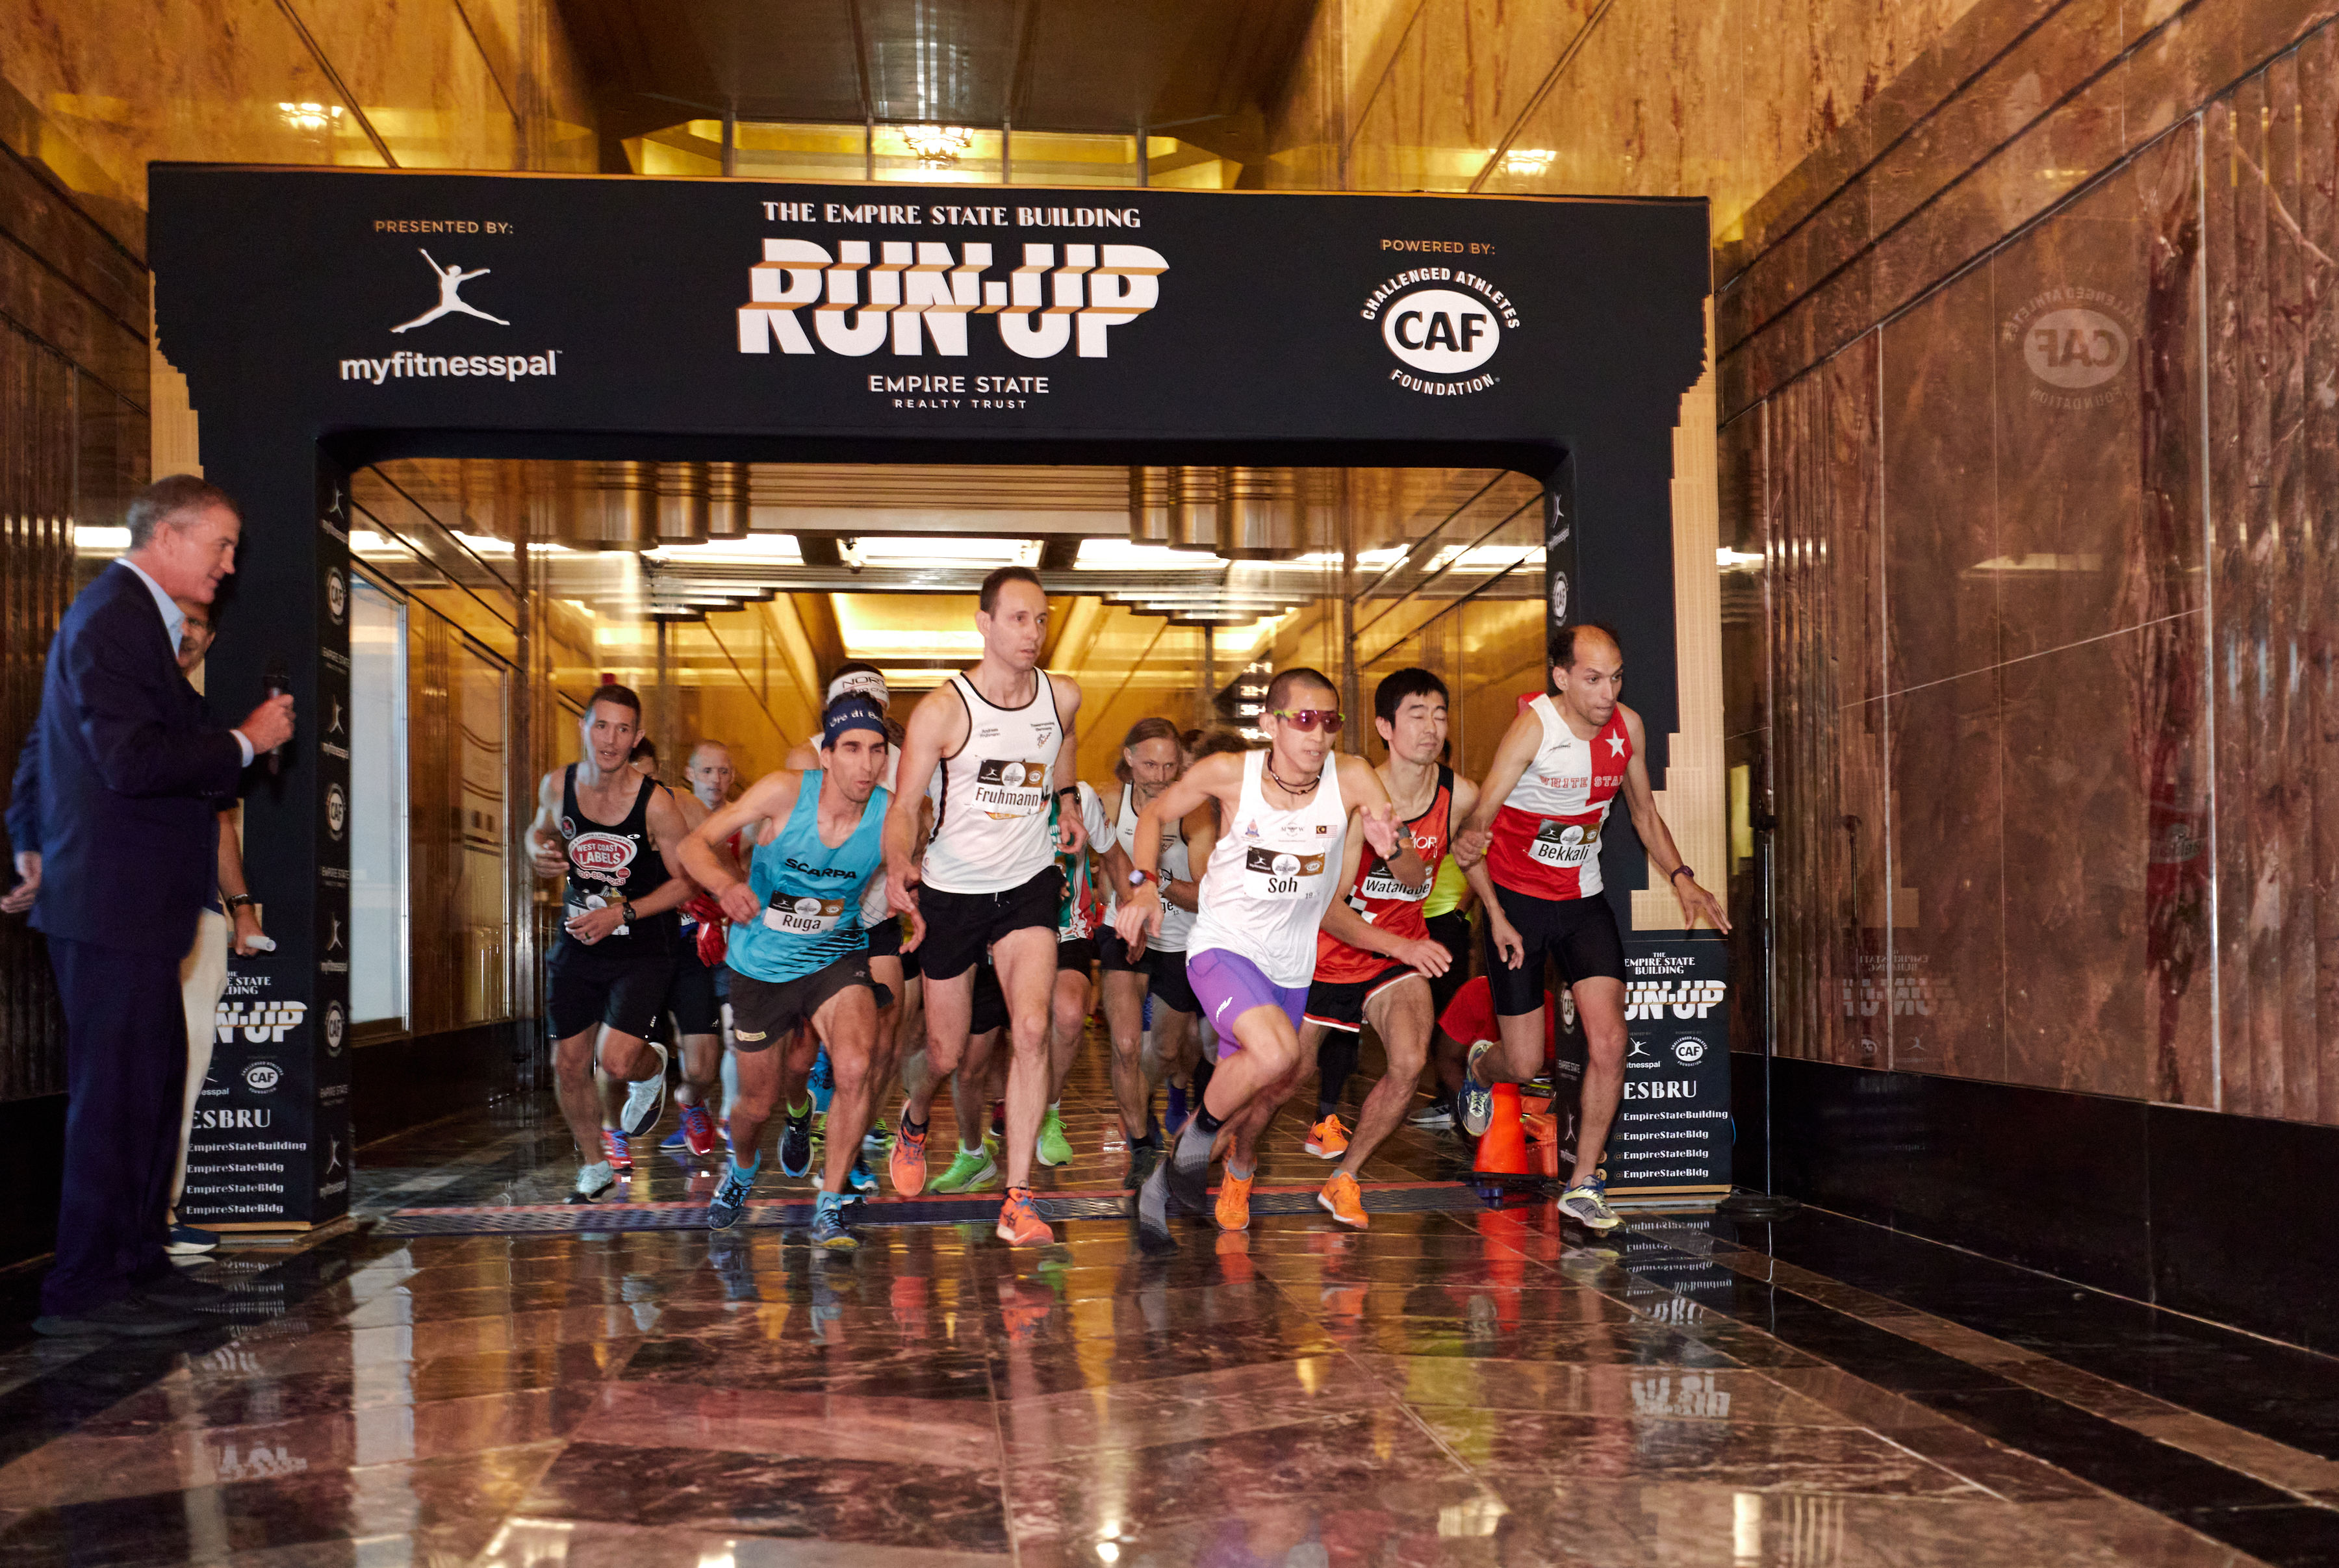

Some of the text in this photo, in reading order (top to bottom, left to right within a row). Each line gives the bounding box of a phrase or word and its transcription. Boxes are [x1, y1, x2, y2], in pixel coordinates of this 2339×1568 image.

[763, 201, 1141, 228] THE EMPIRE STATE BUILDING
[374, 220, 514, 234] PRESENTED BY:
[1381, 239, 1496, 255] POWERED BY:
[737, 238, 1170, 359] RUN-UP
[1361, 267, 1520, 329] CHALLENGED ATHLETES
[1395, 310, 1487, 353] CAF
[869, 374, 1049, 394] EMPIRE STATE
[1389, 369, 1495, 396] FOUNDATION
[894, 398, 1027, 409] REALTY TRUST
[1539, 775, 1589, 789] WHITE
[975, 787, 1039, 807] Fruhmann
[577, 844, 619, 852] WEST COAST
[1538, 844, 1591, 861] Bekkali
[580, 852, 620, 865] LABELS
[785, 858, 857, 879] SCARPA
[1268, 877, 1297, 893] Soh
[782, 915, 821, 932] Ruga
[1624, 957, 1695, 967] EMPIRE STATE
[1635, 965, 1684, 975] BUILDING
[236, 976, 272, 986] STATE
[1624, 980, 1727, 1021] UN-UP
[214, 1001, 308, 1043] N-UP
[1678, 1047, 1700, 1056] CAF
[1626, 1061, 1661, 1069] itnesspal
[250, 1072, 275, 1083] CAF
[201, 1088, 229, 1096] esspal
[1624, 1080, 1697, 1100] ESBRU
[192, 1109, 270, 1129] ESBRU
